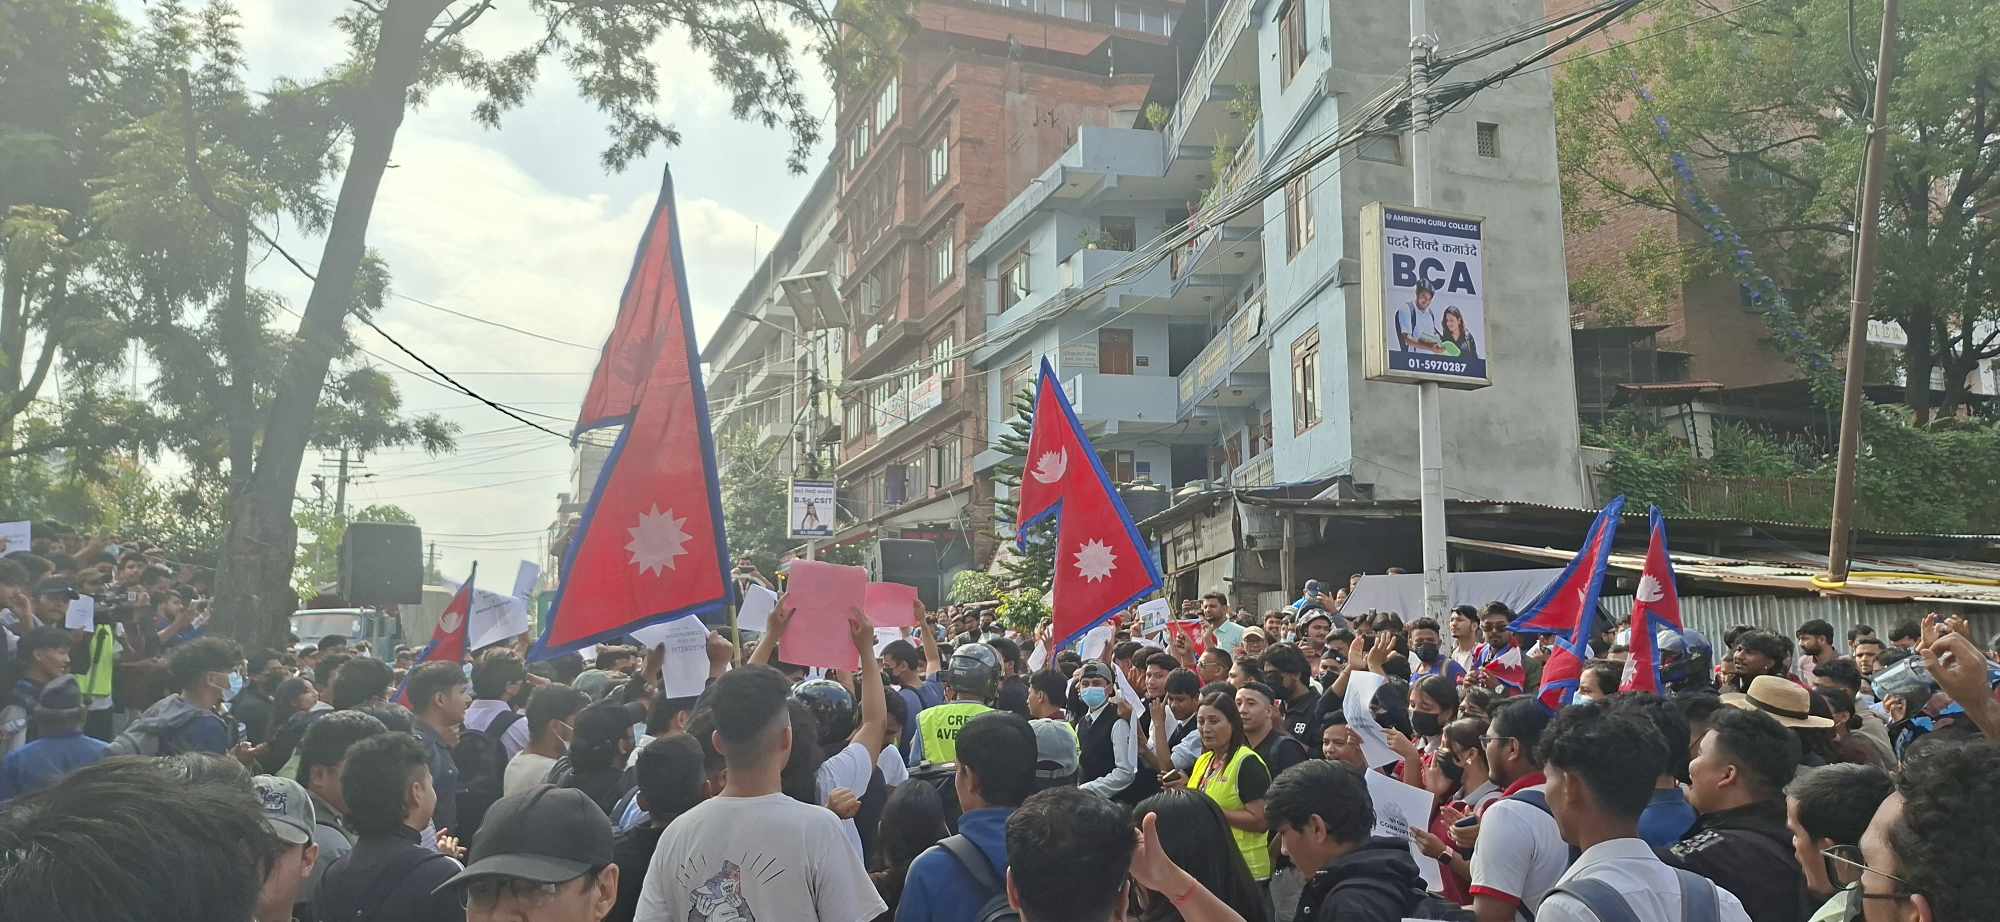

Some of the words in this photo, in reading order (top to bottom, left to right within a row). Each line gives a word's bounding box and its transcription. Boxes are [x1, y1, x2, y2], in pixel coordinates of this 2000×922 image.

[1393, 214, 1426, 225] AMBITION
[1427, 219, 1447, 228] GURU
[1448, 222, 1478, 231] COLLEGE
[1393, 253, 1476, 295] BCA
[1408, 359, 1467, 372] 01-5970287
